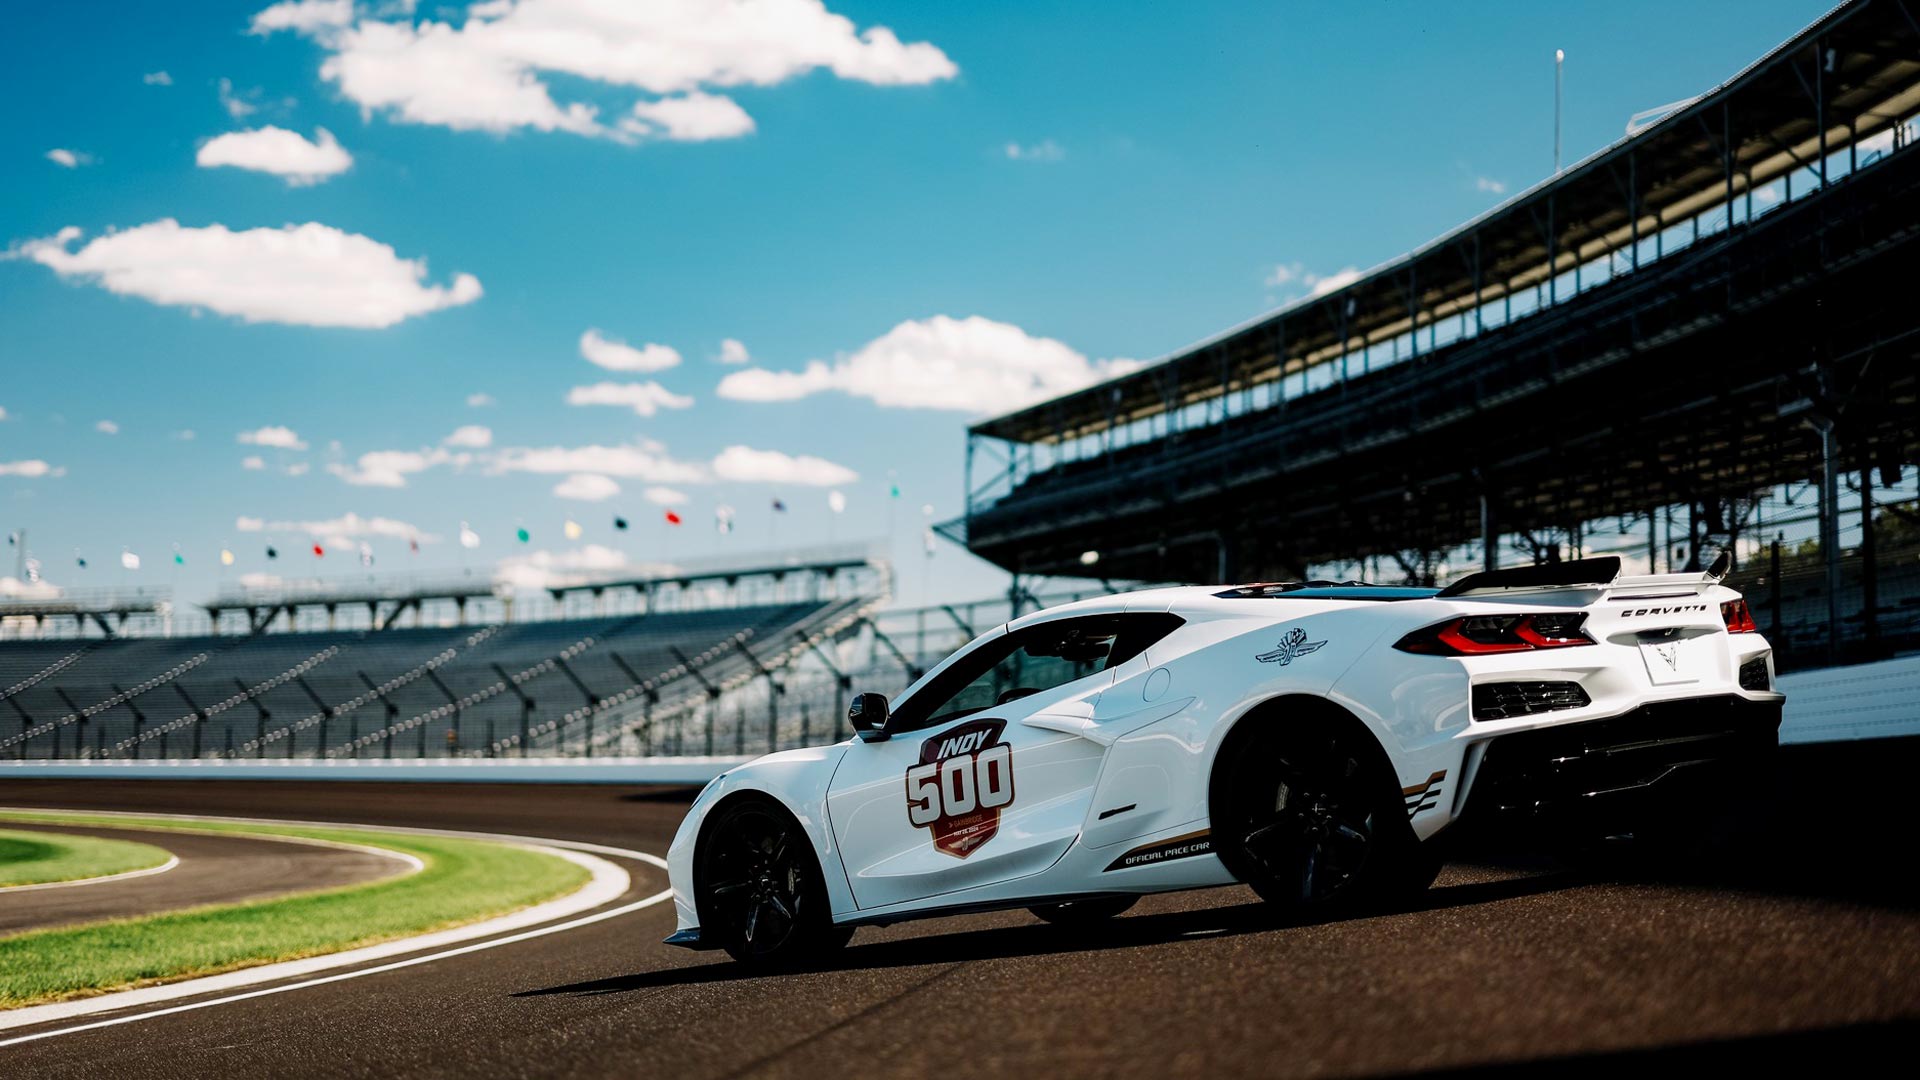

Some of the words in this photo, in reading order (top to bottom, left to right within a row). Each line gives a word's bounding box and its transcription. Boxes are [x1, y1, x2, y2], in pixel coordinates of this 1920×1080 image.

[1620, 604, 1707, 618] CORVETTE
[937, 728, 993, 760] INDY
[908, 745, 1012, 825] 500
[1125, 852, 1163, 864] OFFICIAL
[1165, 846, 1189, 857] PACE
[1190, 842, 1210, 852] CAR
